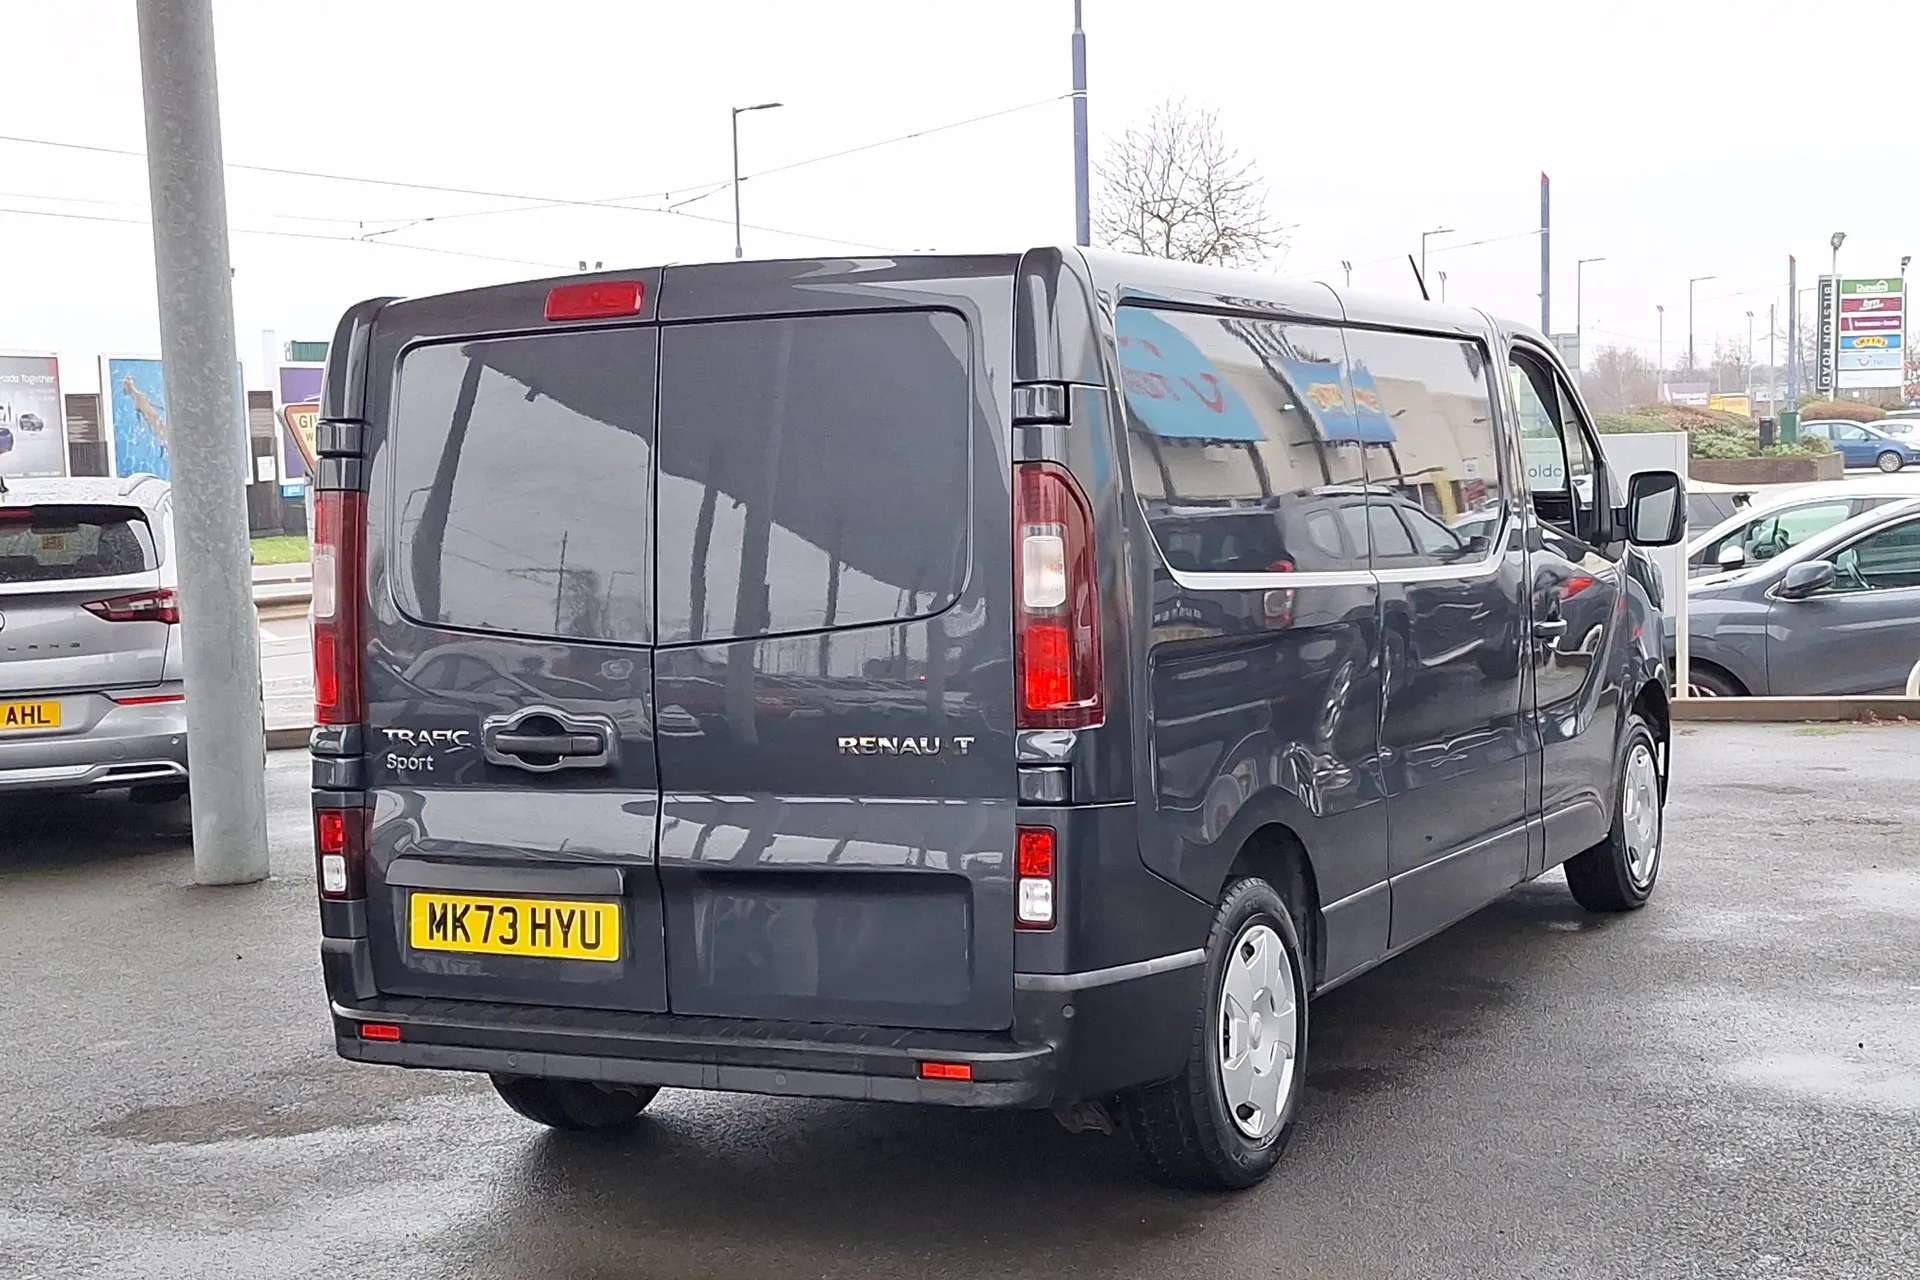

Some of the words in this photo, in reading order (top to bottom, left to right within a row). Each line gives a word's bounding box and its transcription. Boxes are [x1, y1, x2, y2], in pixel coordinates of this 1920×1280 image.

[1821, 349, 1831, 384] ROAD
[6, 705, 51, 725] AHL
[382, 728, 476, 753] TRAFIC
[837, 736, 975, 755] RENAUT
[386, 753, 434, 773] Sport
[428, 902, 518, 945] MK73
[530, 907, 601, 950] HYU
